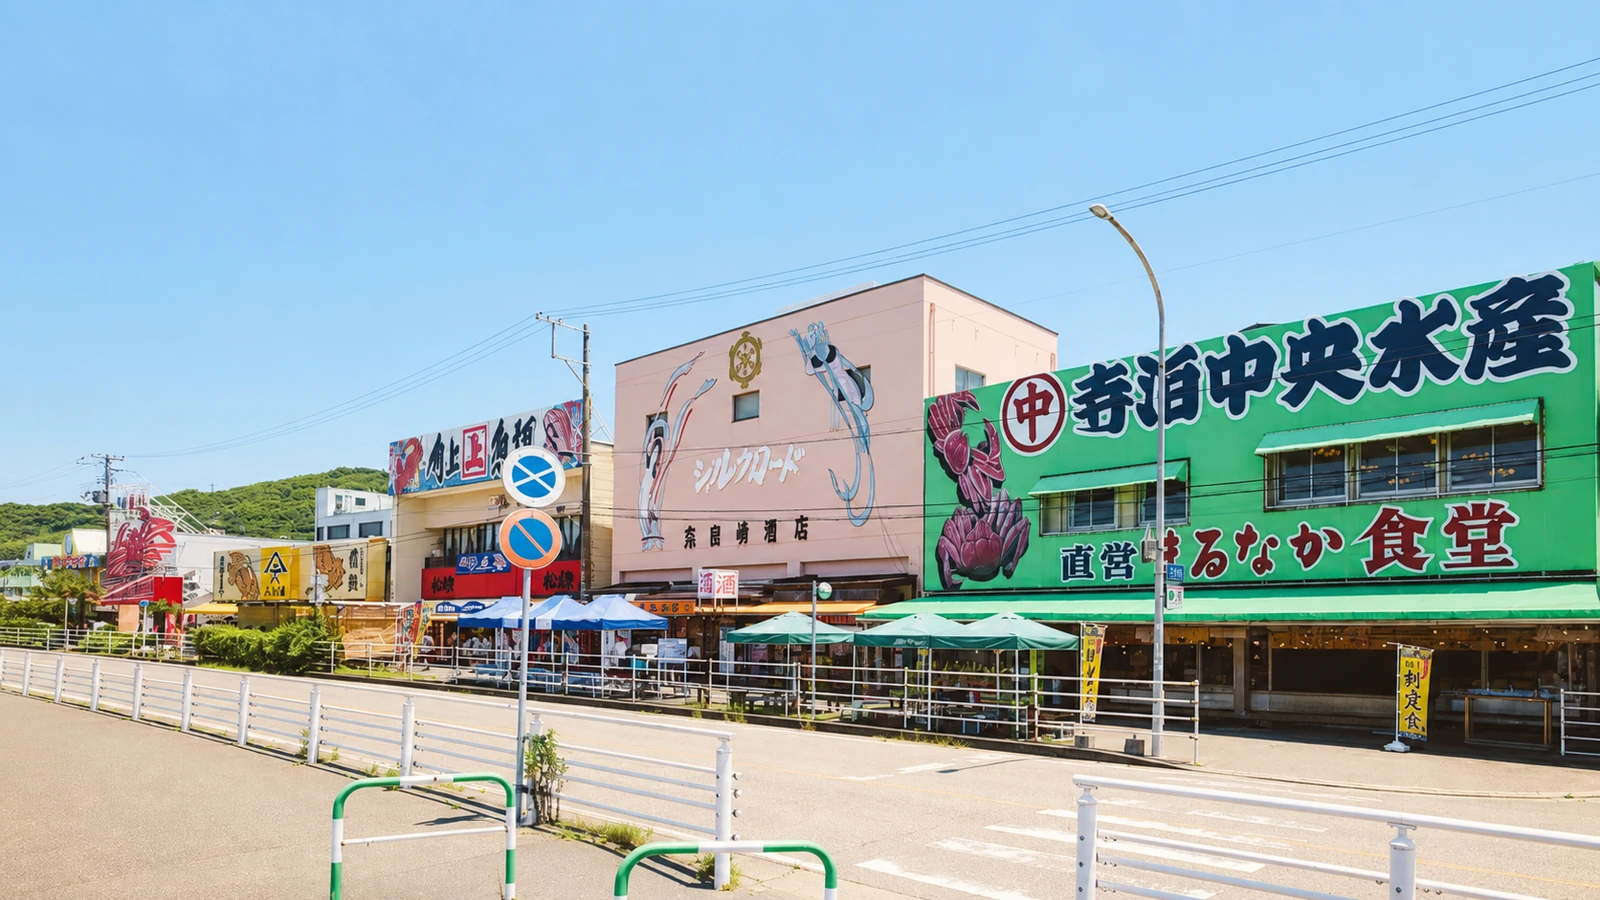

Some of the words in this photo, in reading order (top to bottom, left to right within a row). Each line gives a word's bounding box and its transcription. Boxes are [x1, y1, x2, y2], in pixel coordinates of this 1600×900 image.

[1072, 272, 1576, 438] 寺泊中央水産
[693, 443, 806, 494] シルクロード
[716, 574, 736, 595] 酒
[1060, 542, 1137, 582] 直営
